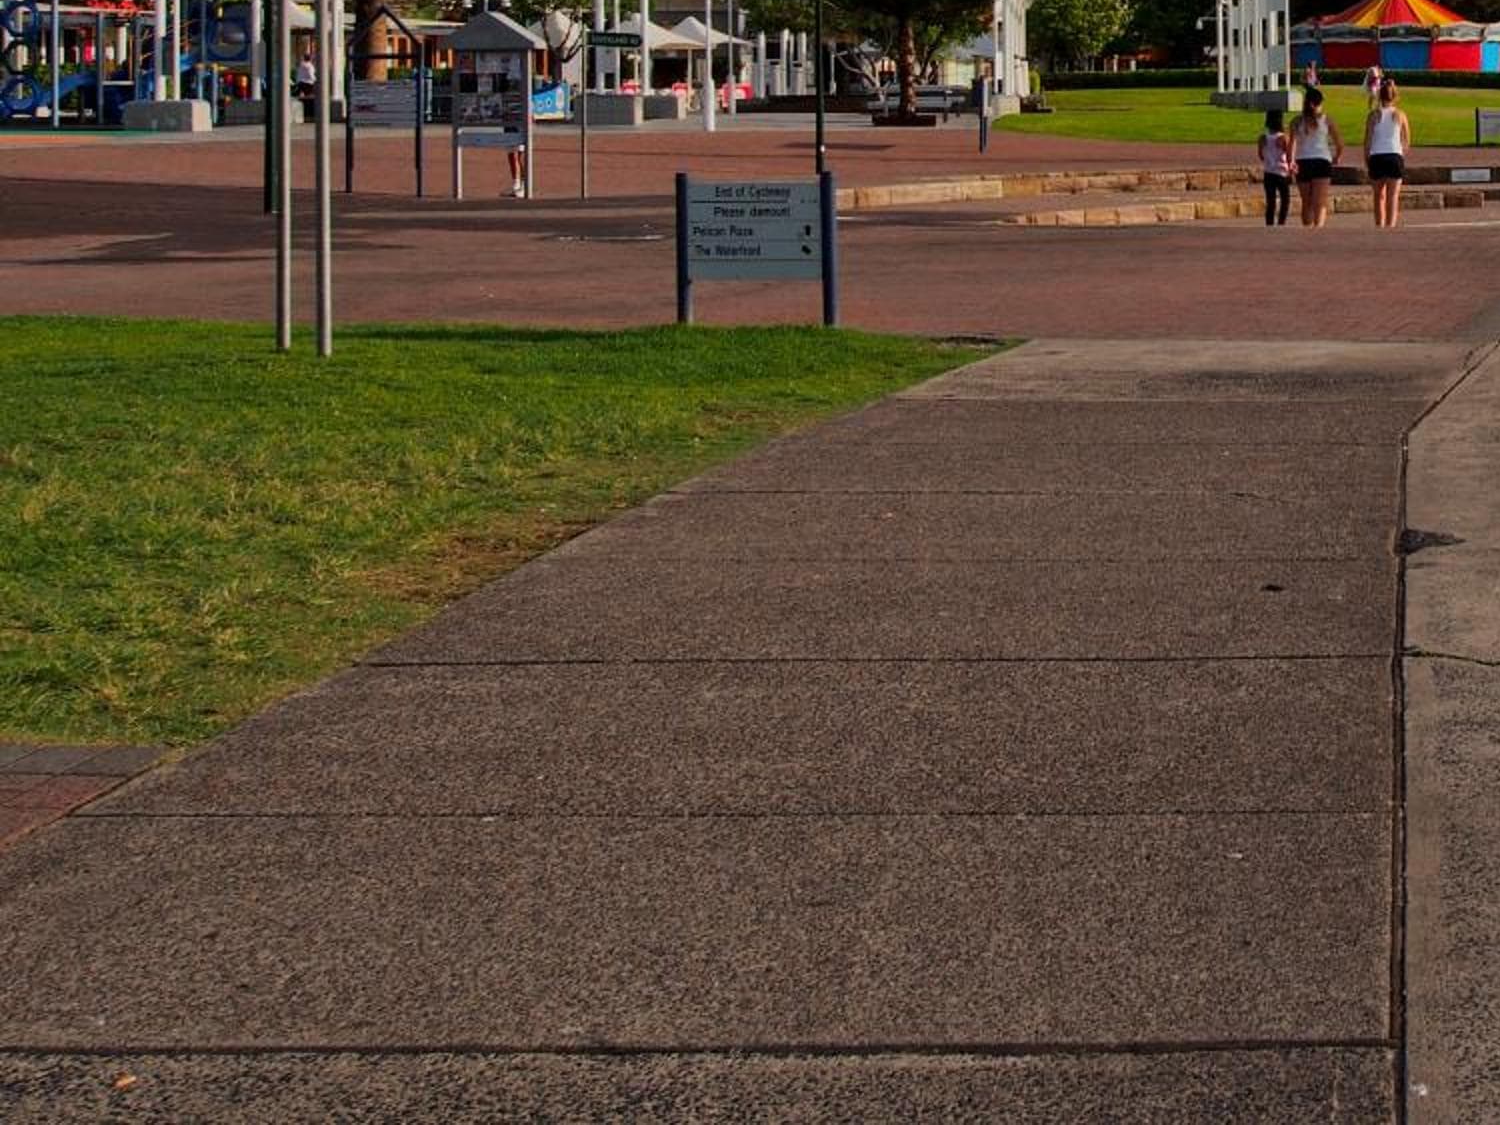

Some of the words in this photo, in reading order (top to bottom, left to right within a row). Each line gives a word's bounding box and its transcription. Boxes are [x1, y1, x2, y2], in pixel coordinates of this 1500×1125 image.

[715, 186, 733, 198] End
[735, 186, 746, 198] of
[713, 206, 745, 218] Please
